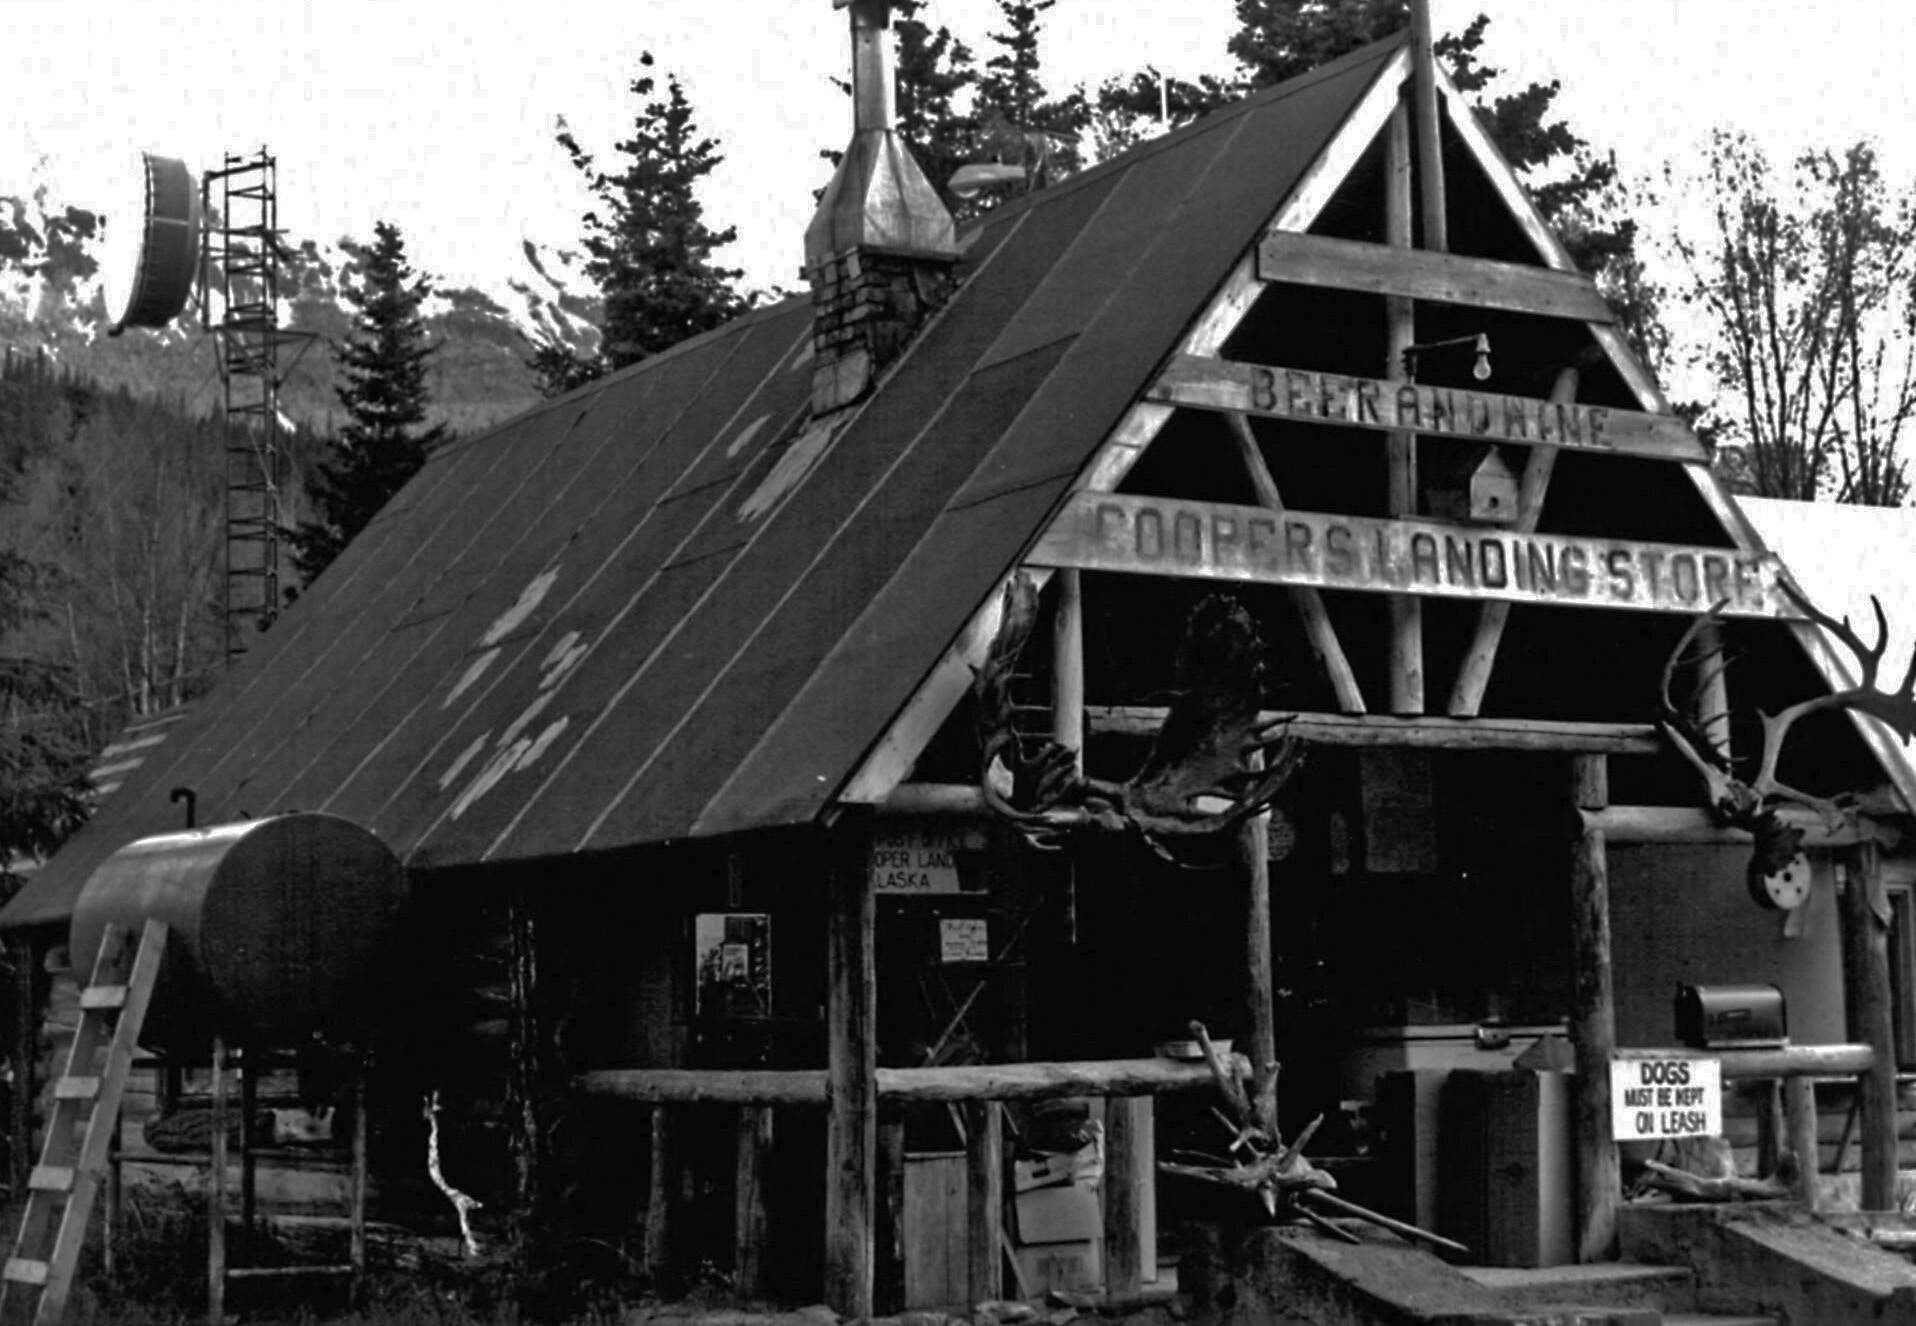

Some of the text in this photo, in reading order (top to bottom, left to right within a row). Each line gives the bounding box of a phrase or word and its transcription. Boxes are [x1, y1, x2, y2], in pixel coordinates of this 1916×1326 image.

[1249, 365, 1615, 448] BEER AND WINE
[1096, 501, 1764, 611] COOPERS LANDING STORE
[875, 851, 956, 869] OPER LAND
[878, 871, 931, 889] LASKA
[1641, 1061, 1691, 1085] DOGS
[1624, 1086, 1705, 1107] MUST BE KEPT
[1635, 1110, 1707, 1134] ON LEASH
